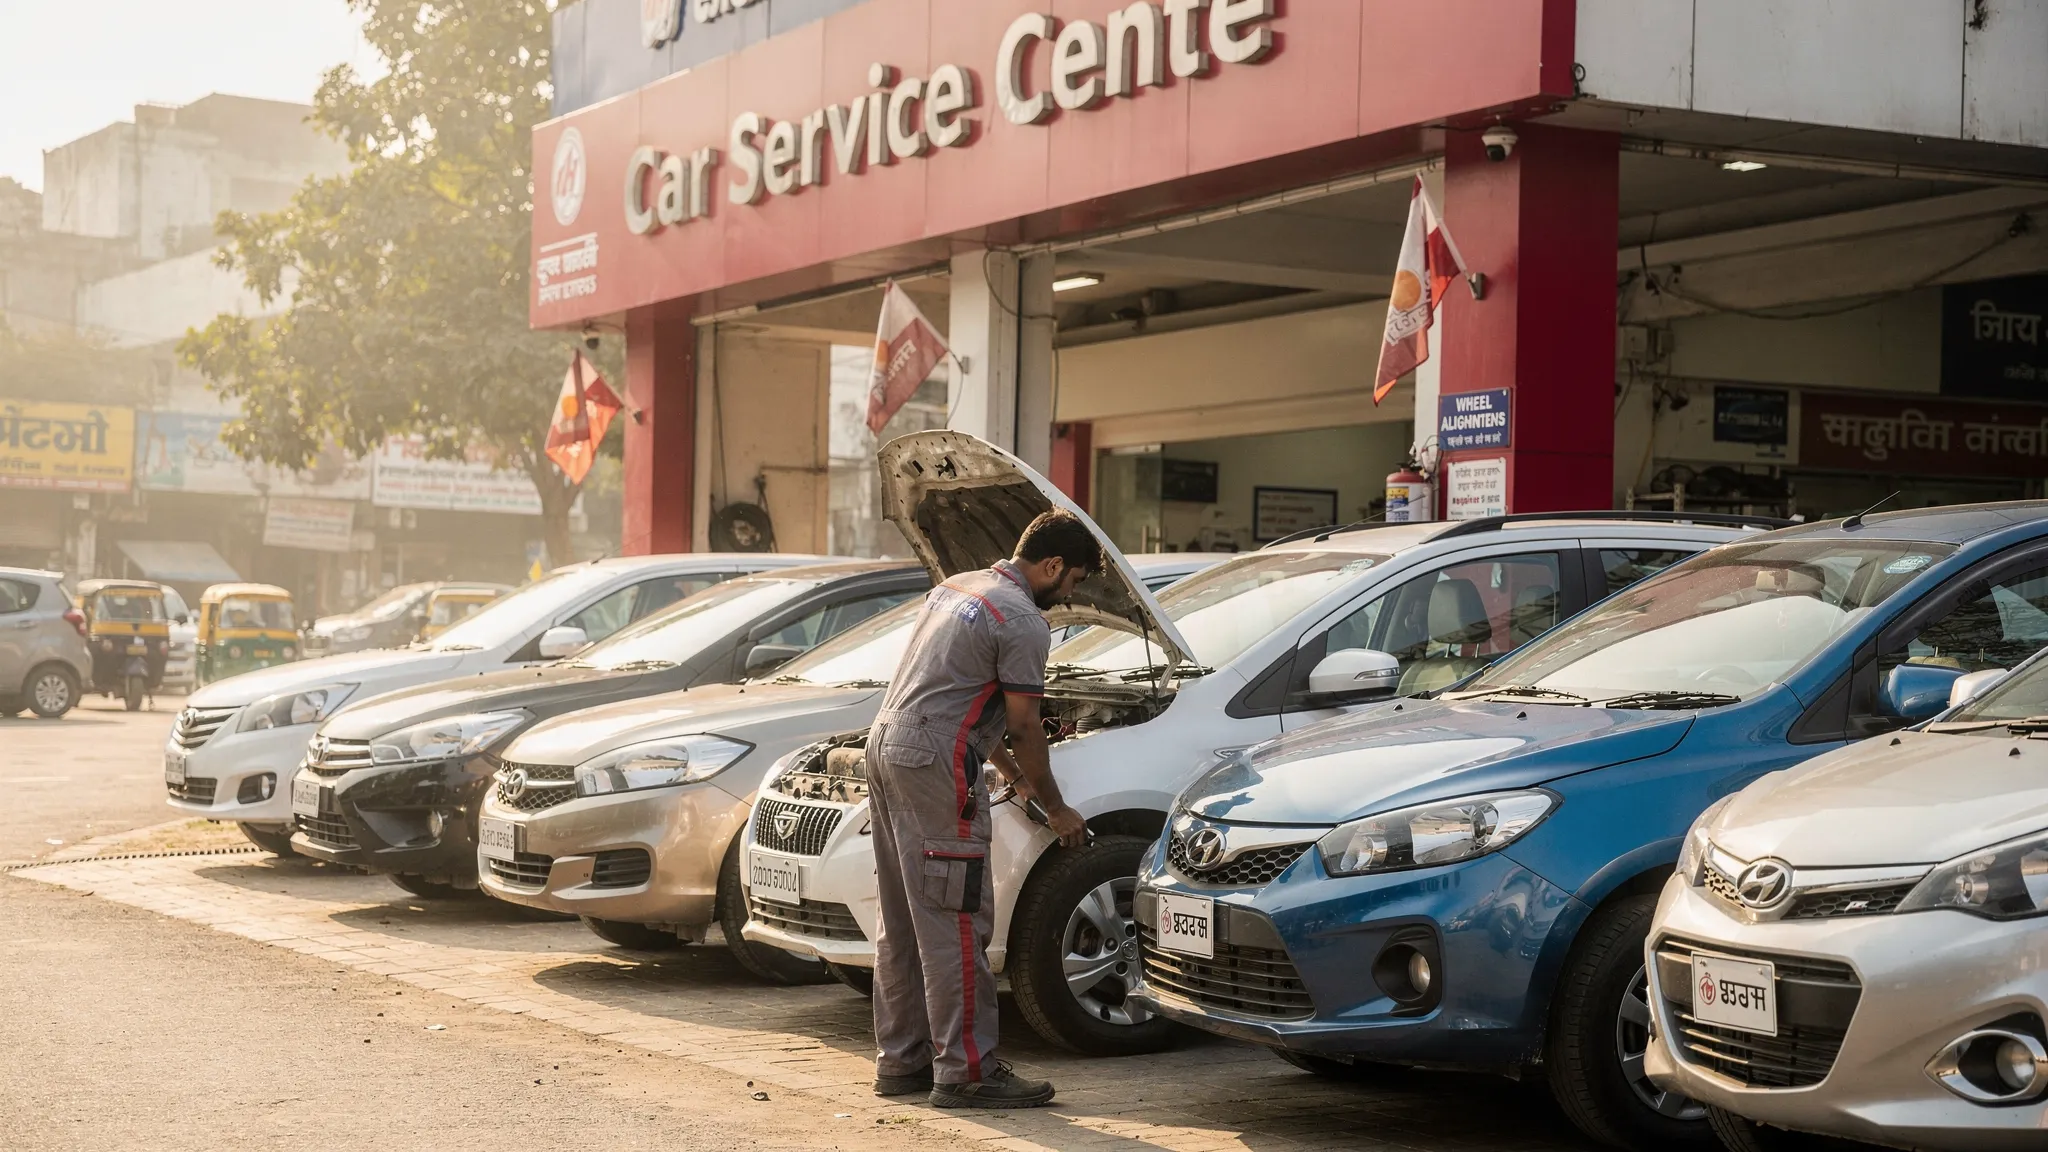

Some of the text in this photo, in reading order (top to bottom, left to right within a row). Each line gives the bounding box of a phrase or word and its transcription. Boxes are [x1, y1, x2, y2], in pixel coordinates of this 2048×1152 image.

[624, 0, 1274, 235] Car Service Cente
[1456, 395, 1493, 412] WHEEL
